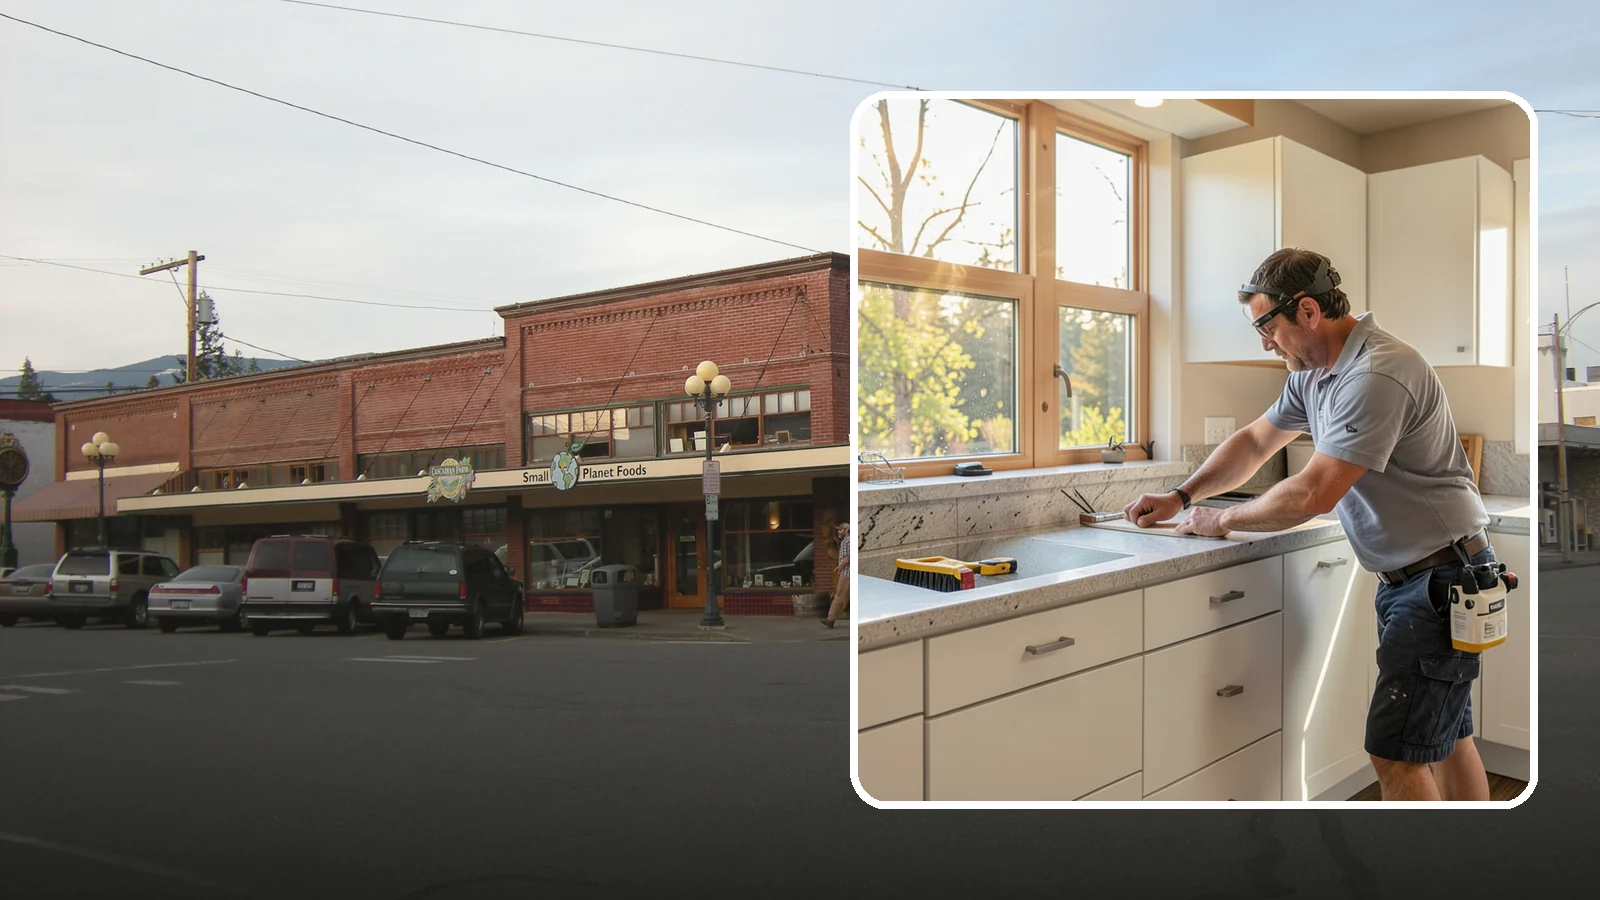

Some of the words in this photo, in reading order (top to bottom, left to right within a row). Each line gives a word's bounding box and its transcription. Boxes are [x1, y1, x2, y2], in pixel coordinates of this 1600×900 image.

[523, 470, 549, 483] Small
[583, 467, 614, 479] Planet
[617, 464, 647, 477] Foods
